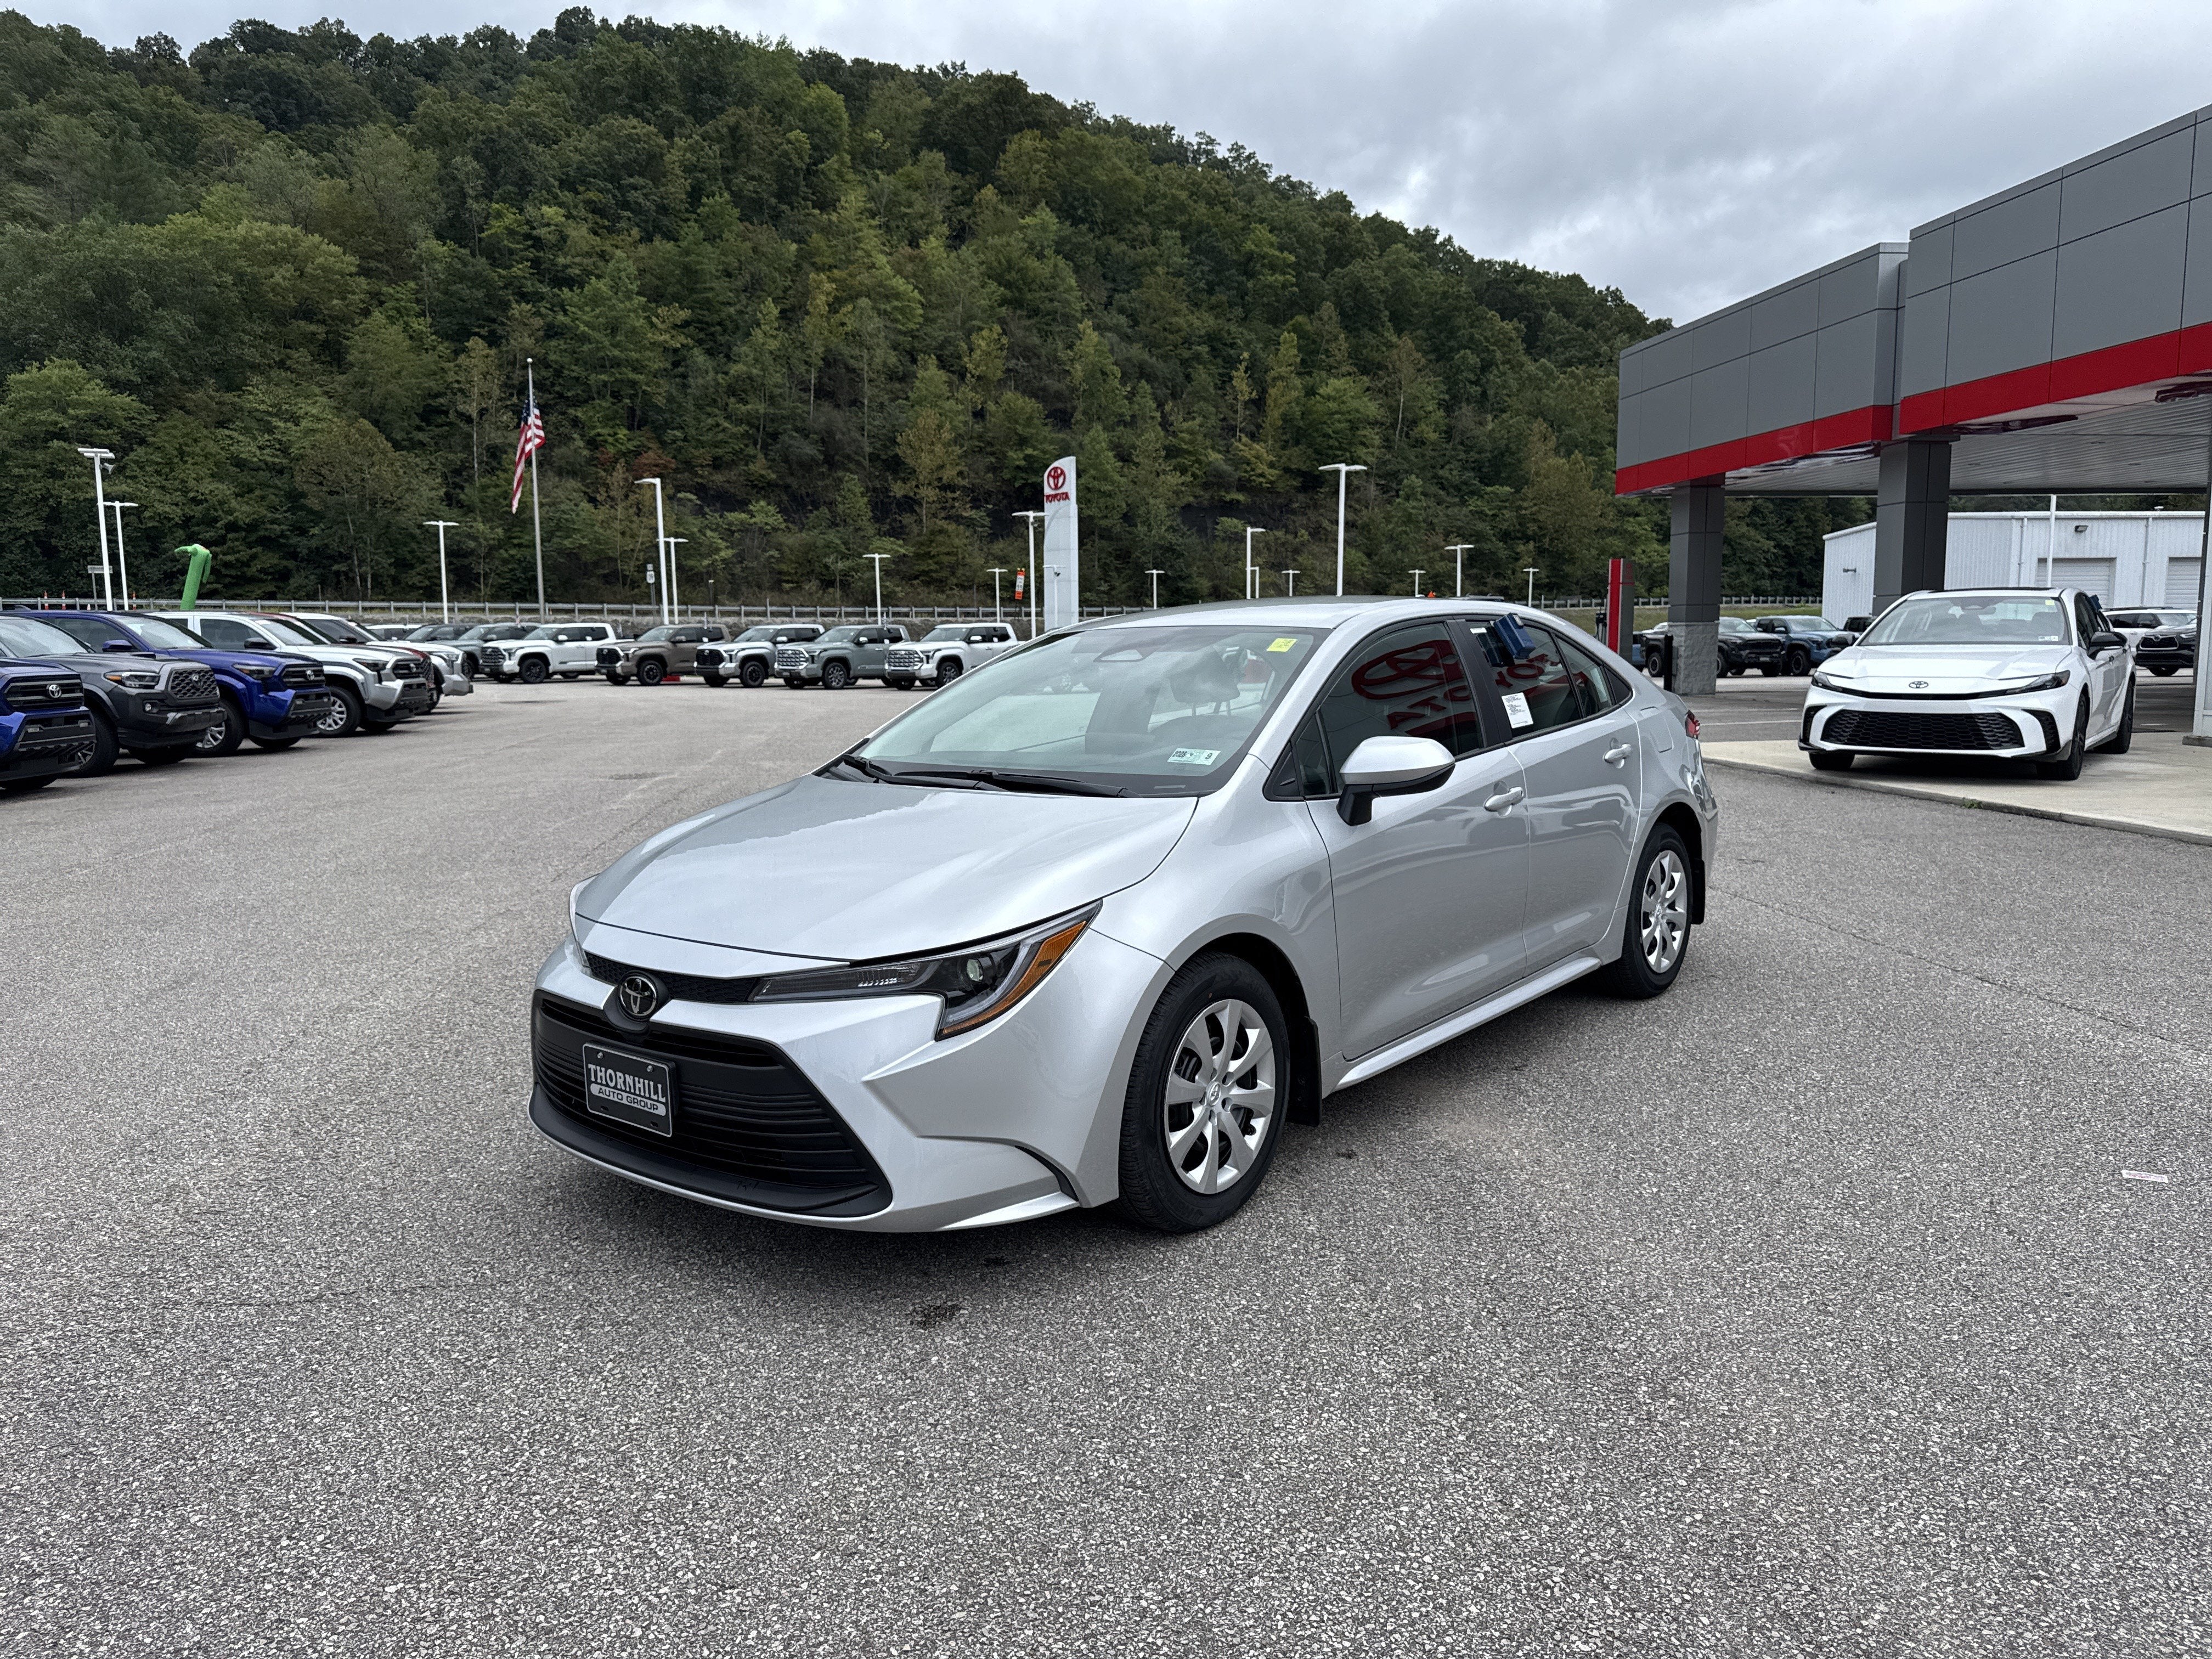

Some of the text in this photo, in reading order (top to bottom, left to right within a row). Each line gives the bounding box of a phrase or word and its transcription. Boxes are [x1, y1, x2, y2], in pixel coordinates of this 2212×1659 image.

[1045, 492, 1070, 503] TOYOTA
[588, 1064, 666, 1103] THORNHILL
[598, 1087, 658, 1111] AUTO GROUP
